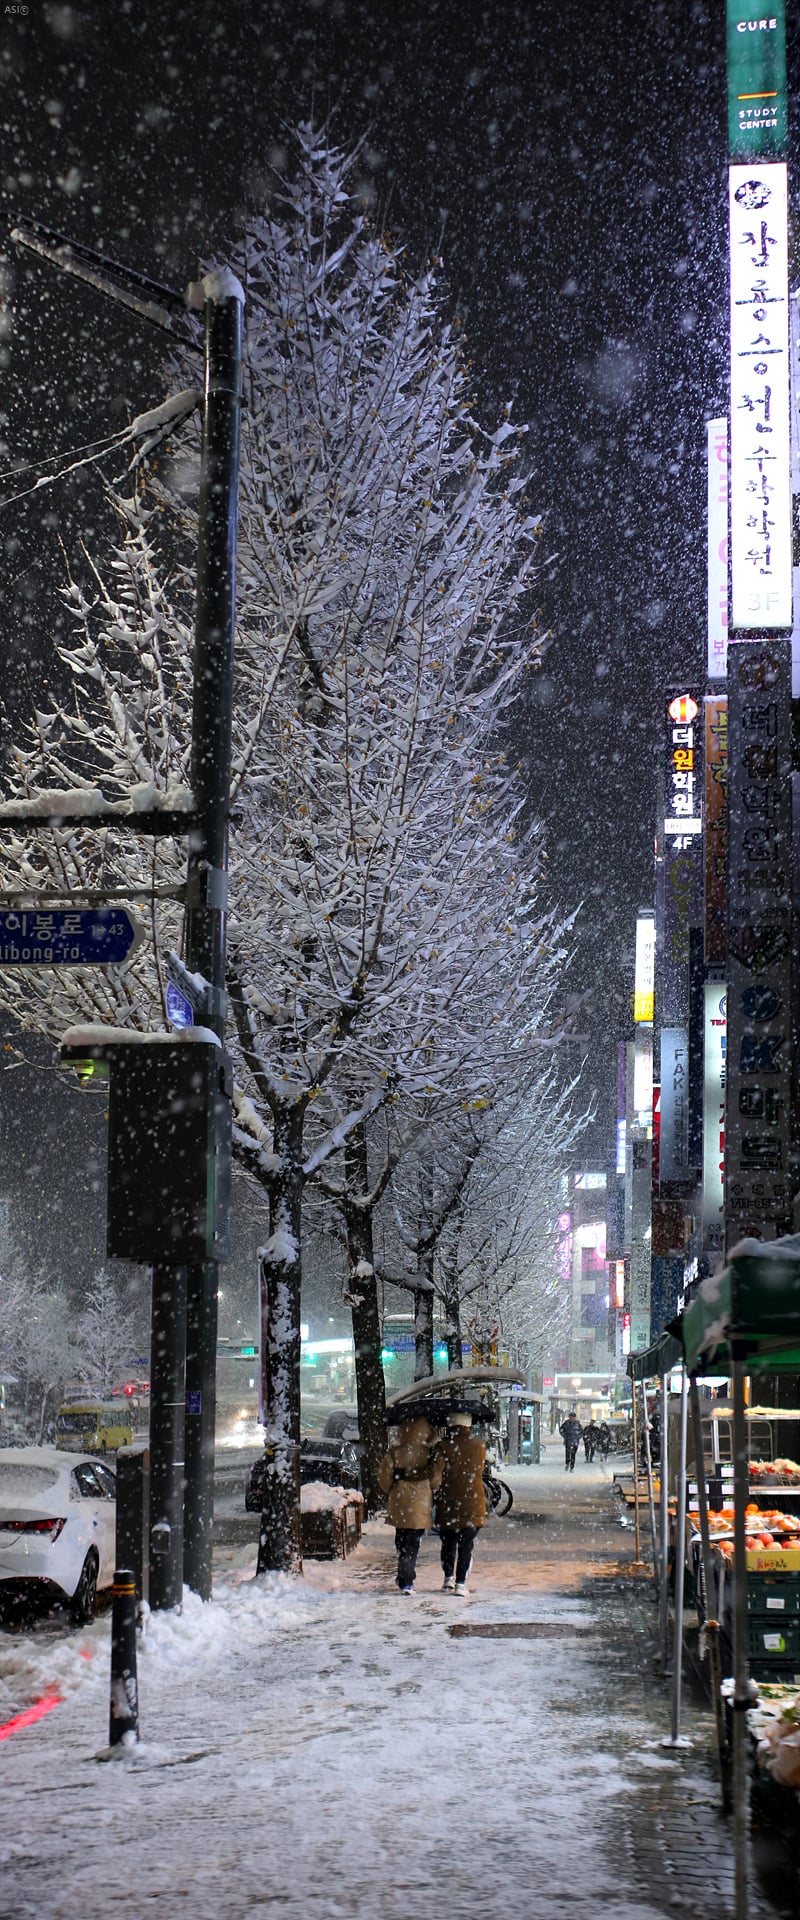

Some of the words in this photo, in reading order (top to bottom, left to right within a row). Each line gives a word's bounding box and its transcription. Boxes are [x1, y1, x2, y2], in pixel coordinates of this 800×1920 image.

[736, 18, 778, 33] CURE
[738, 107, 778, 118] STUDY
[738, 118, 778, 130] CENTER
[748, 592, 780, 611] 3F
[671, 727, 697, 815] 더원학원
[672, 836, 693, 850] 4F
[673, 1048, 685, 1091] FAK
